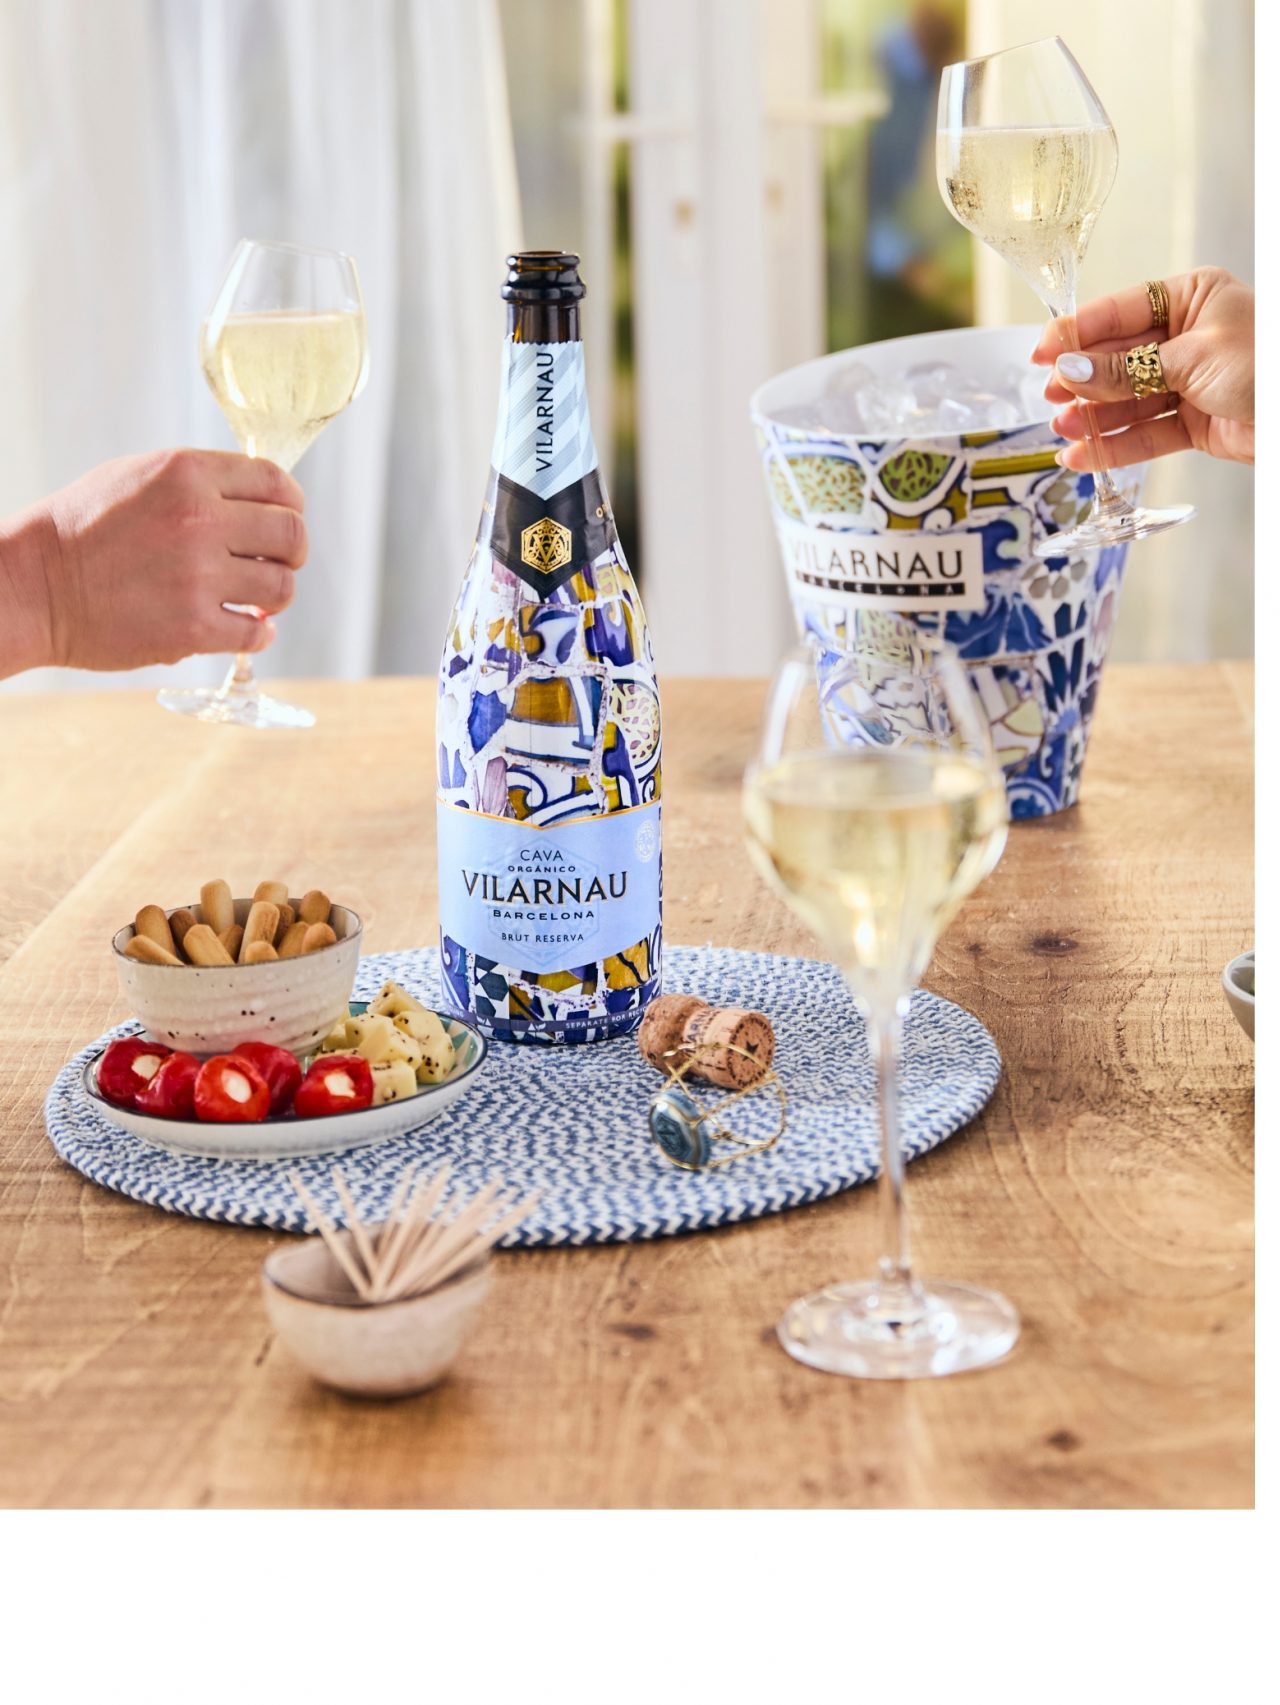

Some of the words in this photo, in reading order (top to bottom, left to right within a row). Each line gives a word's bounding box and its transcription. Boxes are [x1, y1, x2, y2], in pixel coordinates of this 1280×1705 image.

[536, 351, 554, 473] VILARNAU
[788, 541, 964, 579] VILARNAU
[520, 849, 564, 862] CAVA
[507, 865, 576, 873] ORGÁNICO
[461, 869, 628, 905] VILARNAU
[493, 909, 595, 921] BARCELONA
[501, 932, 530, 943] BRUT
[535, 933, 584, 943] RESERVA
[565, 1018, 608, 1029] SEPARATE
[611, 1014, 626, 1022] FOR
[628, 1006, 646, 1018] RECYC
